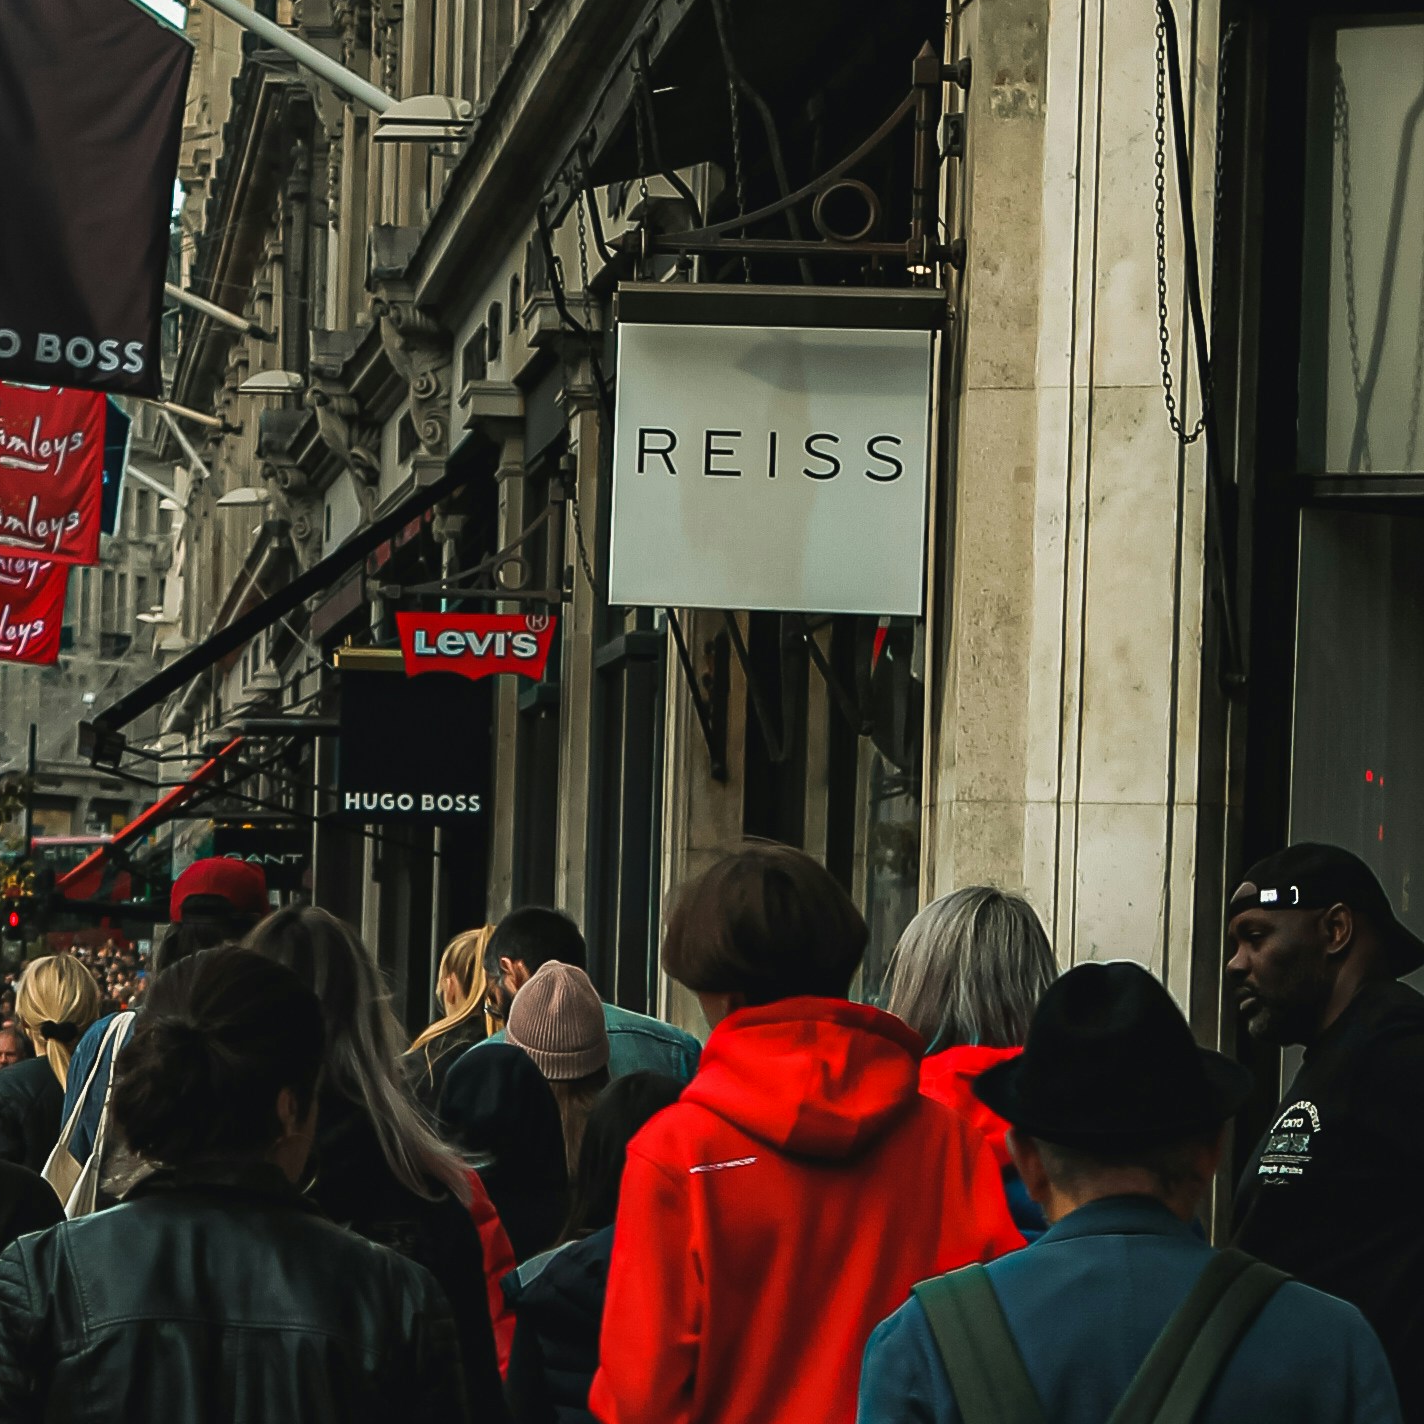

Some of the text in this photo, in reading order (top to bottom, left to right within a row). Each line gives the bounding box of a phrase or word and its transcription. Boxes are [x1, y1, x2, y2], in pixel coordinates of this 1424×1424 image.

[35, 333, 144, 374] BOSS
[637, 427, 904, 482] REISS
[345, 792, 480, 812] HUGO BOSS
